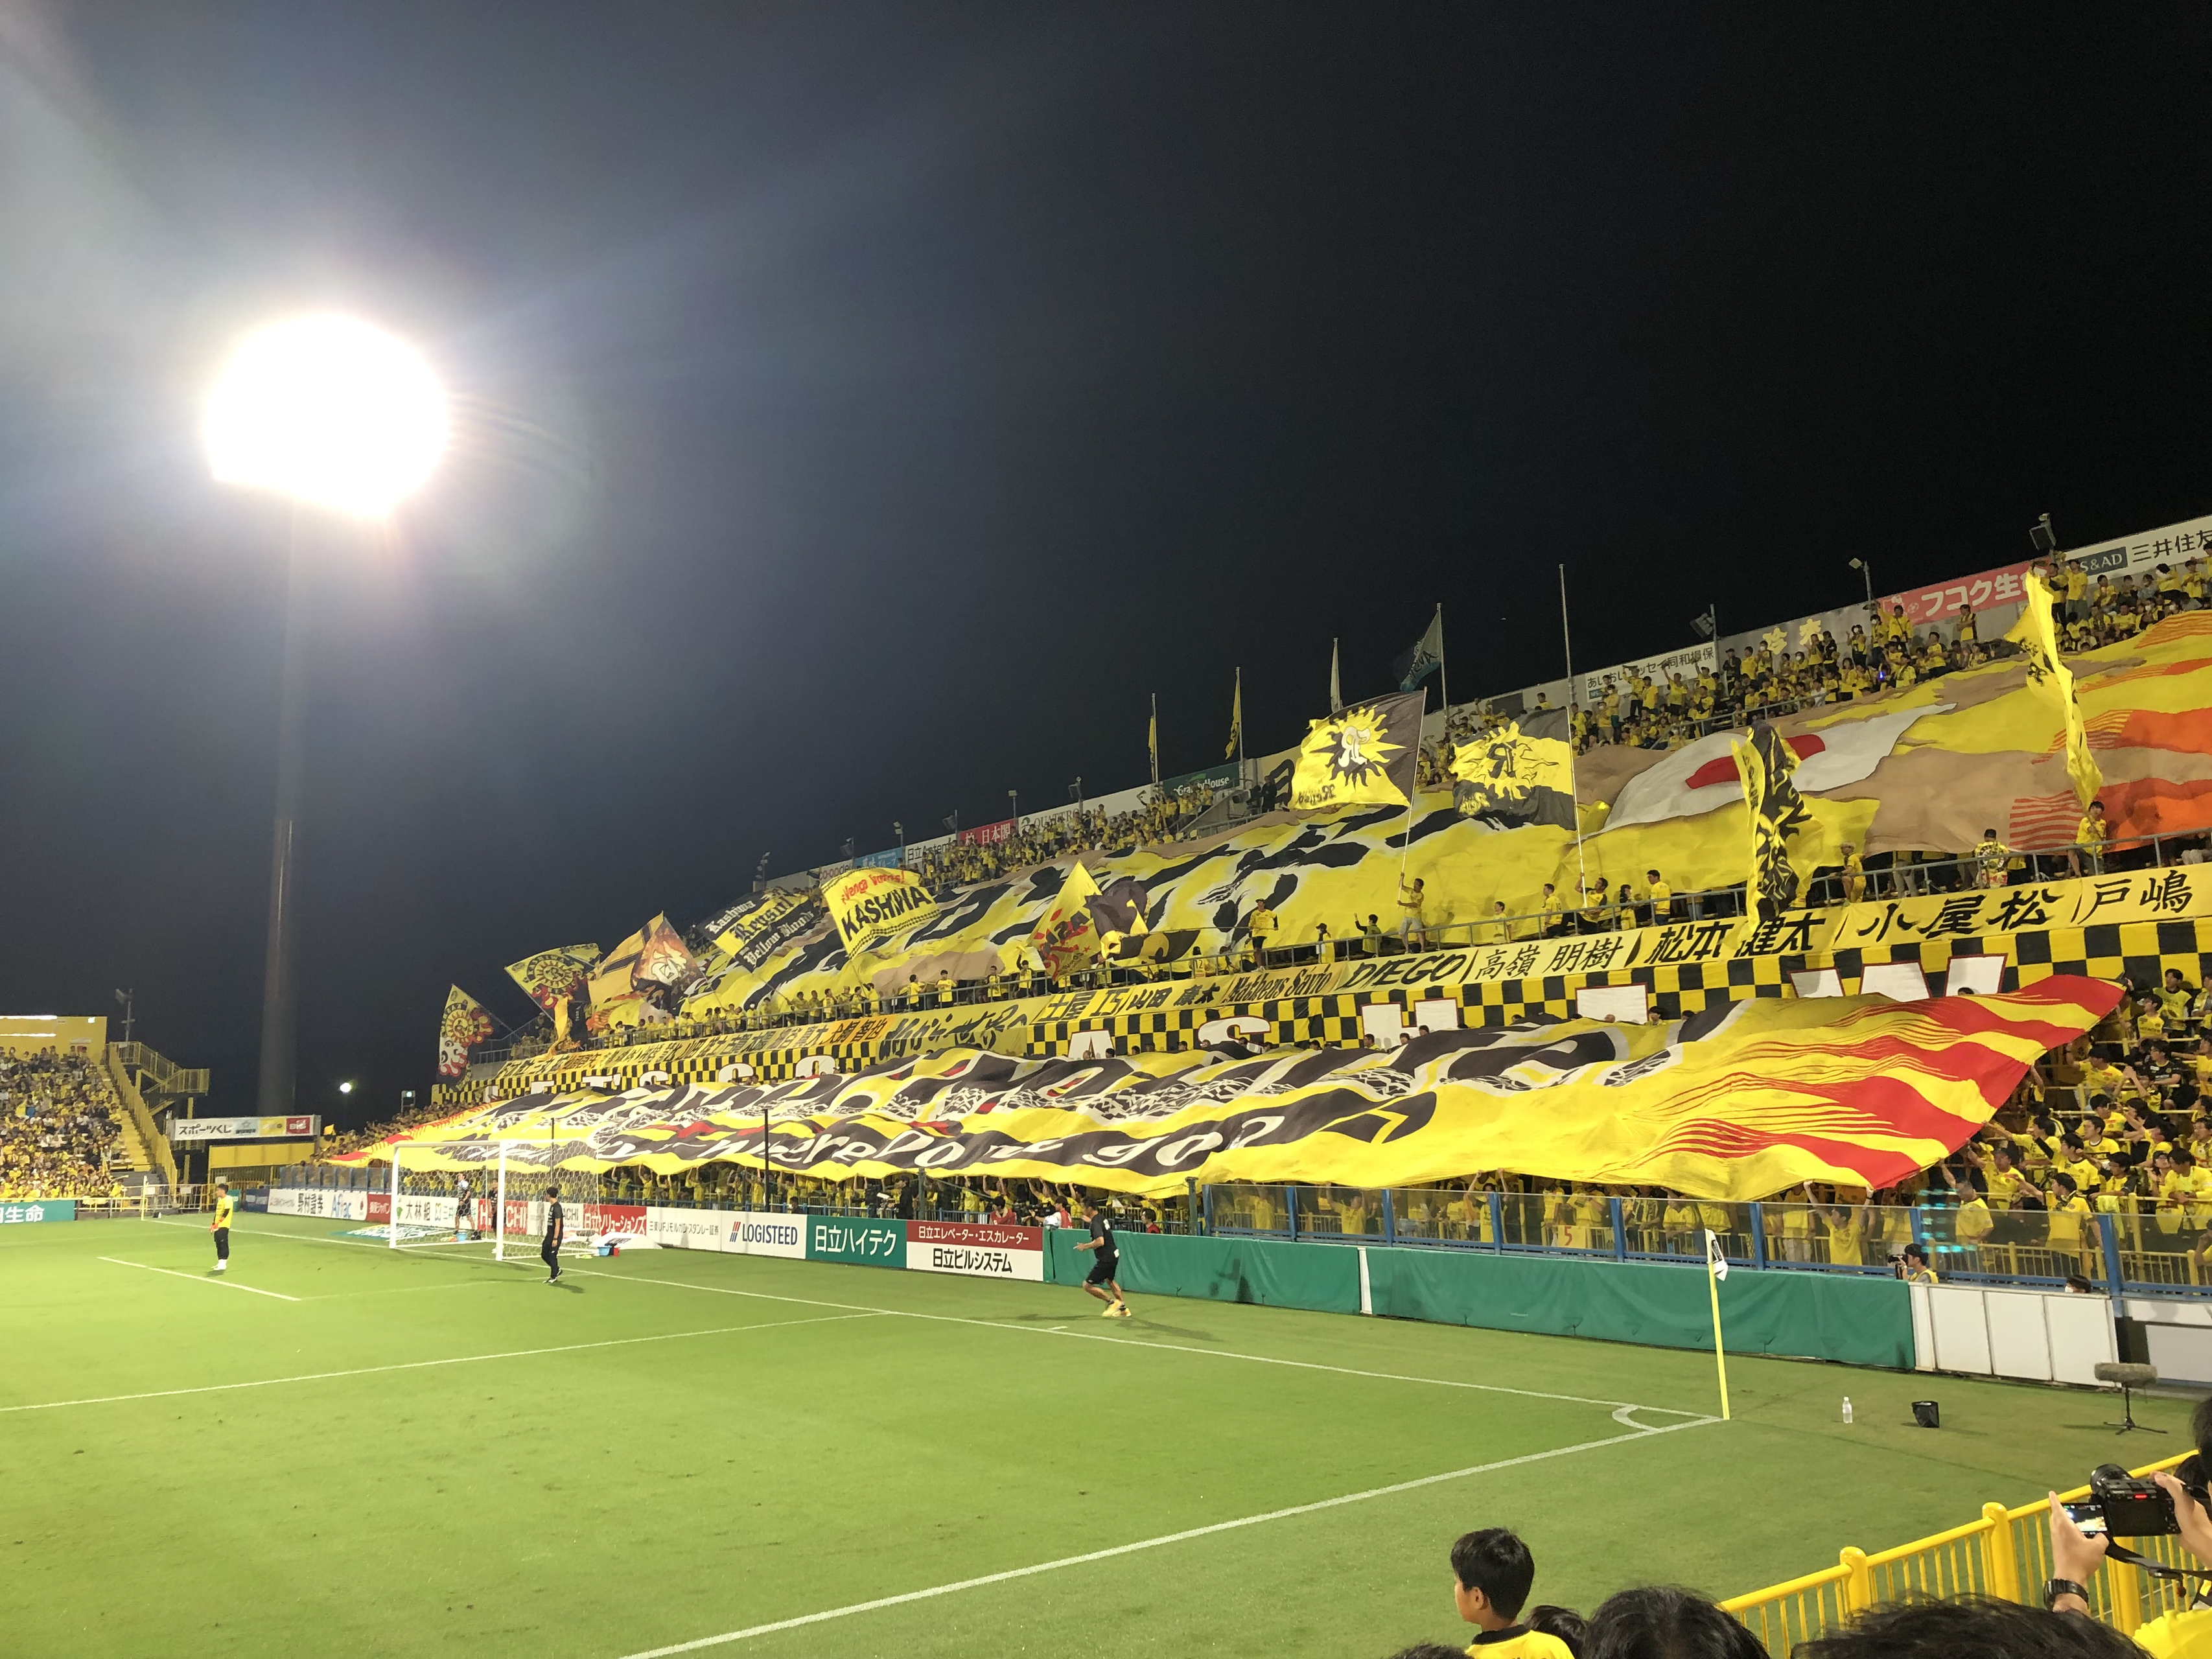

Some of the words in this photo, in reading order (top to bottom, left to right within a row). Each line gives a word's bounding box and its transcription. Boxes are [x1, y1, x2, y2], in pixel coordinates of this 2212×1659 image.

[841, 886, 933, 942] KASHIWA
[1856, 887, 2066, 942] 小屋松
[1334, 953, 1467, 992] DIEGO
[178, 1123, 231, 1135] スポーツくじ
[0, 1204, 45, 1224] 生命
[331, 1194, 352, 1220] Aflac
[742, 1223, 798, 1246] LOGISTEED
[815, 1224, 897, 1257] 日立ハイテク
[918, 1225, 1029, 1245] 日立エレベーター・エスカレーター
[933, 1247, 1012, 1273] 日立ビルシステム
